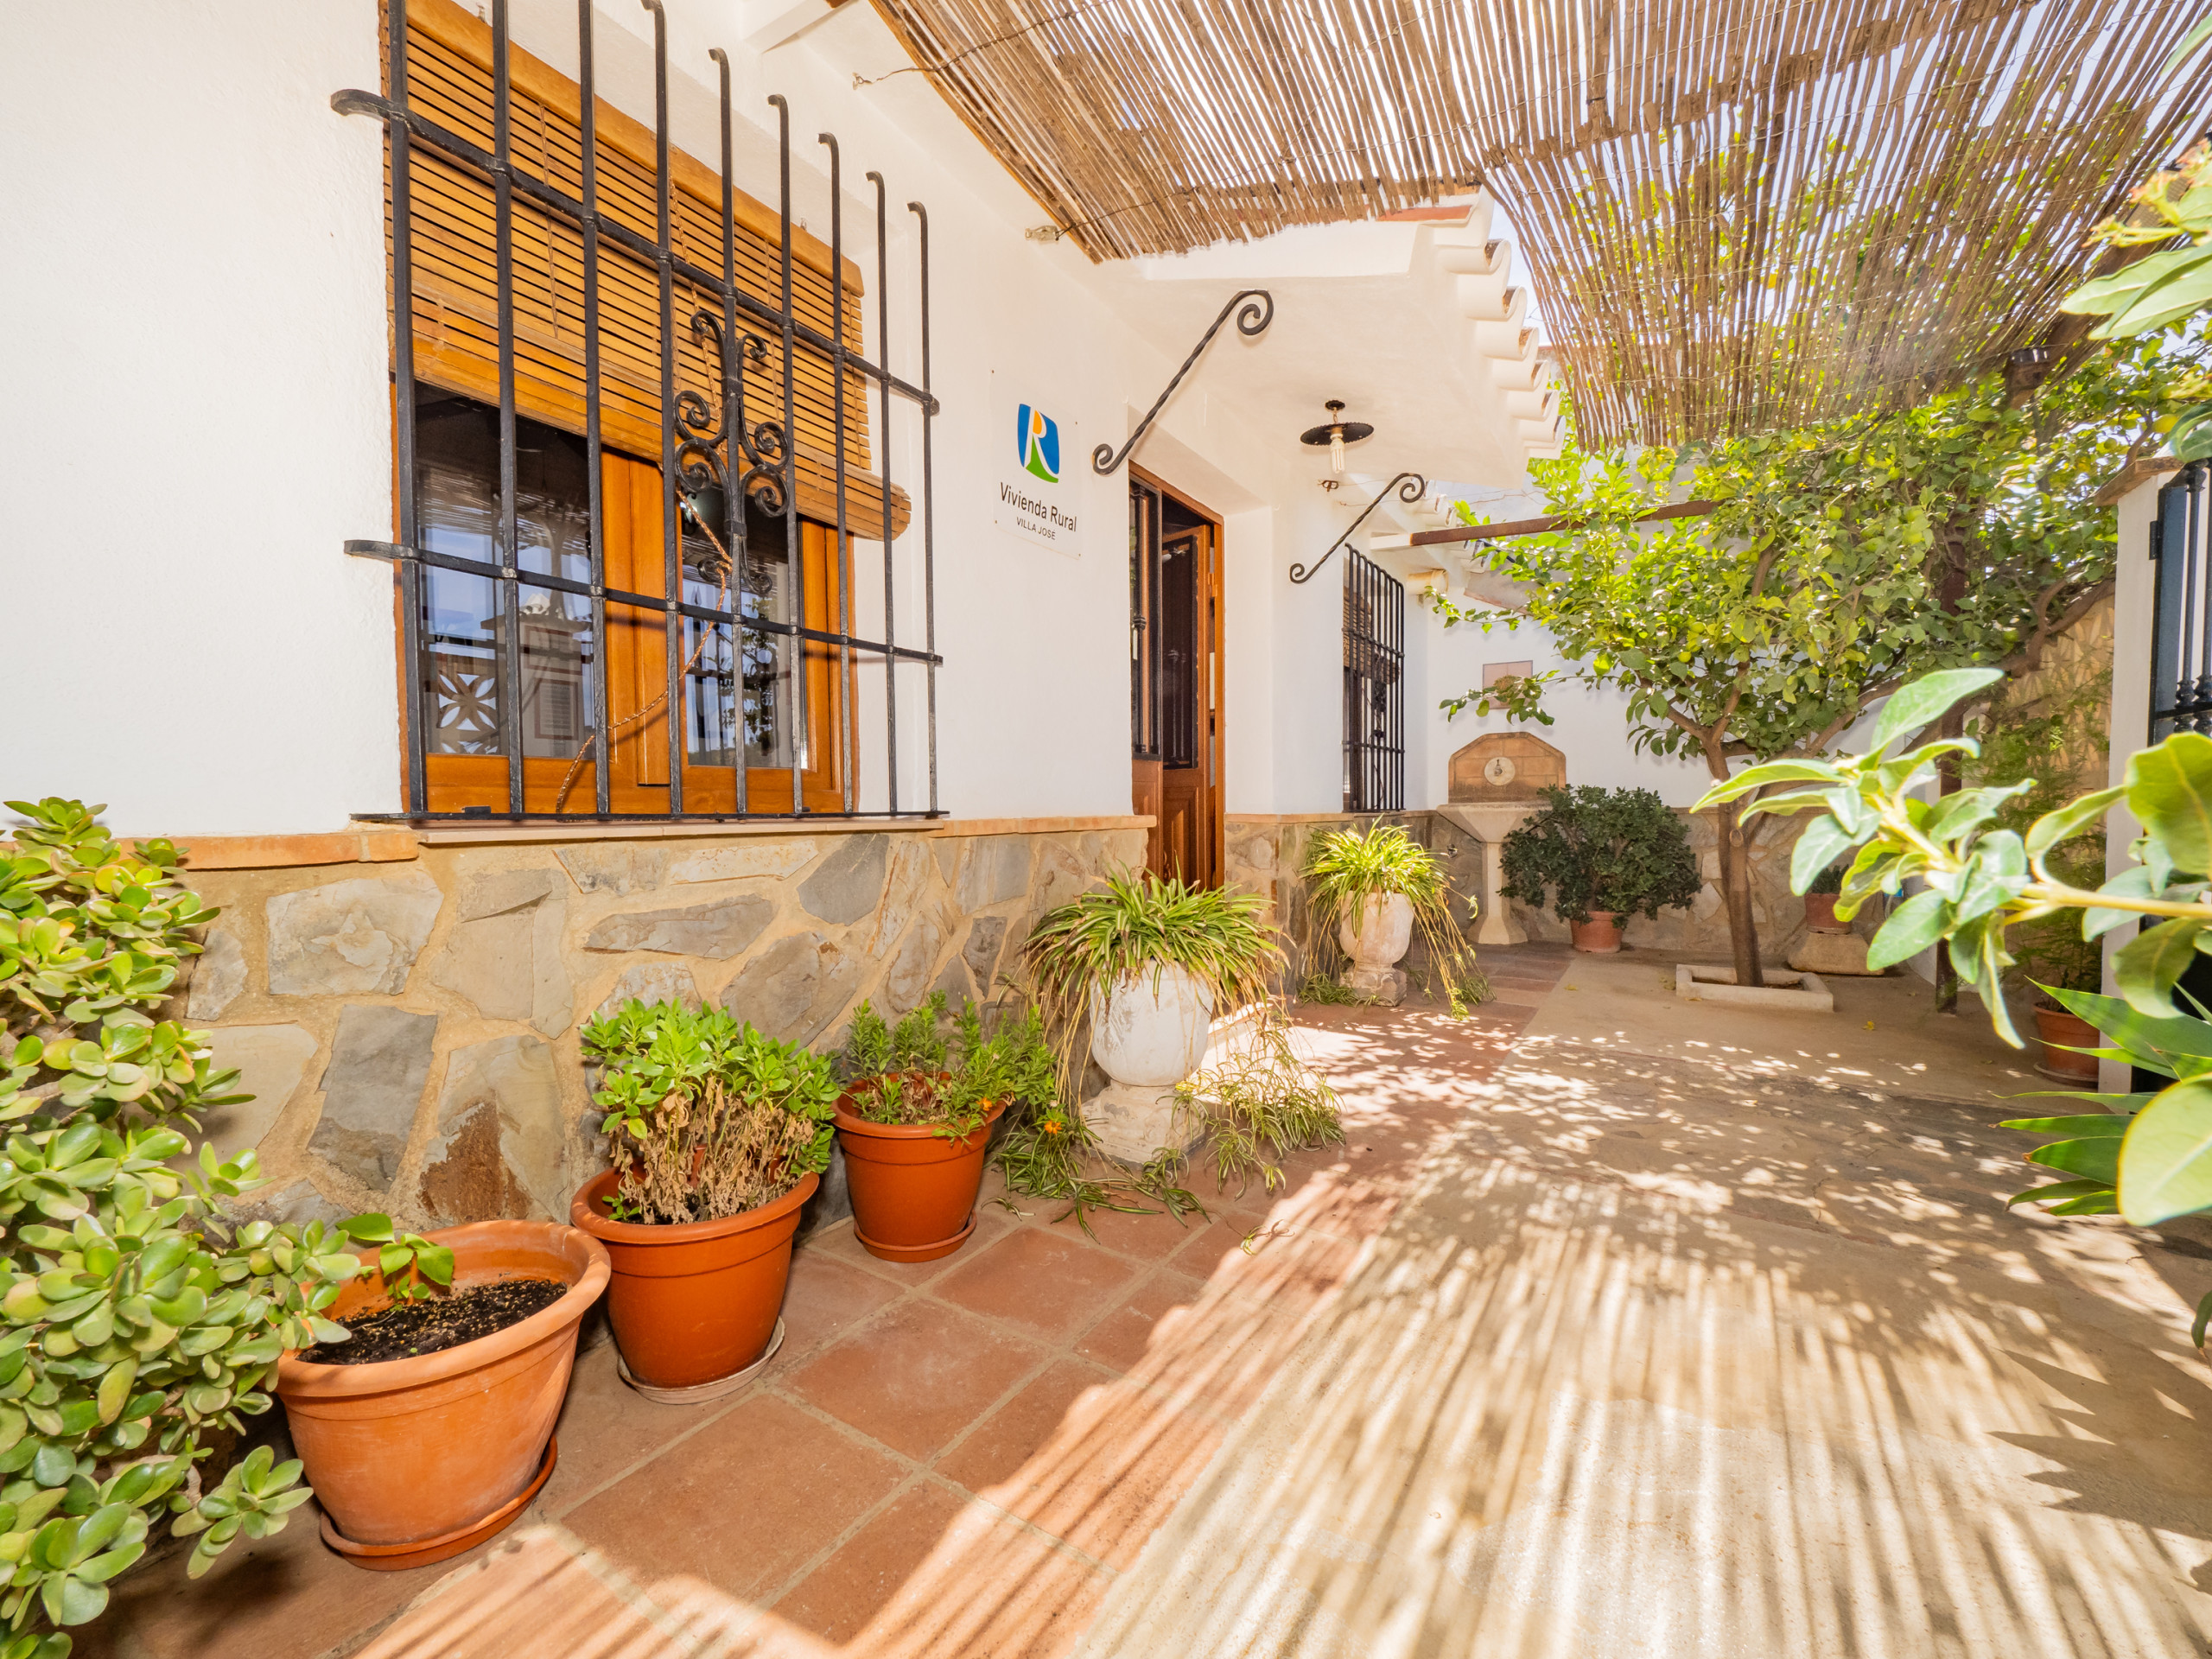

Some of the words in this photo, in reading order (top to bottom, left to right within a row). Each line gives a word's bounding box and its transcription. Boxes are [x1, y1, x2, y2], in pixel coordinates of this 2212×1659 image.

[1000, 481, 1047, 520] Vivienda
[1050, 505, 1077, 532] Rural
[1016, 517, 1037, 532] VILLA
[1038, 526, 1056, 540] JOSÉ
